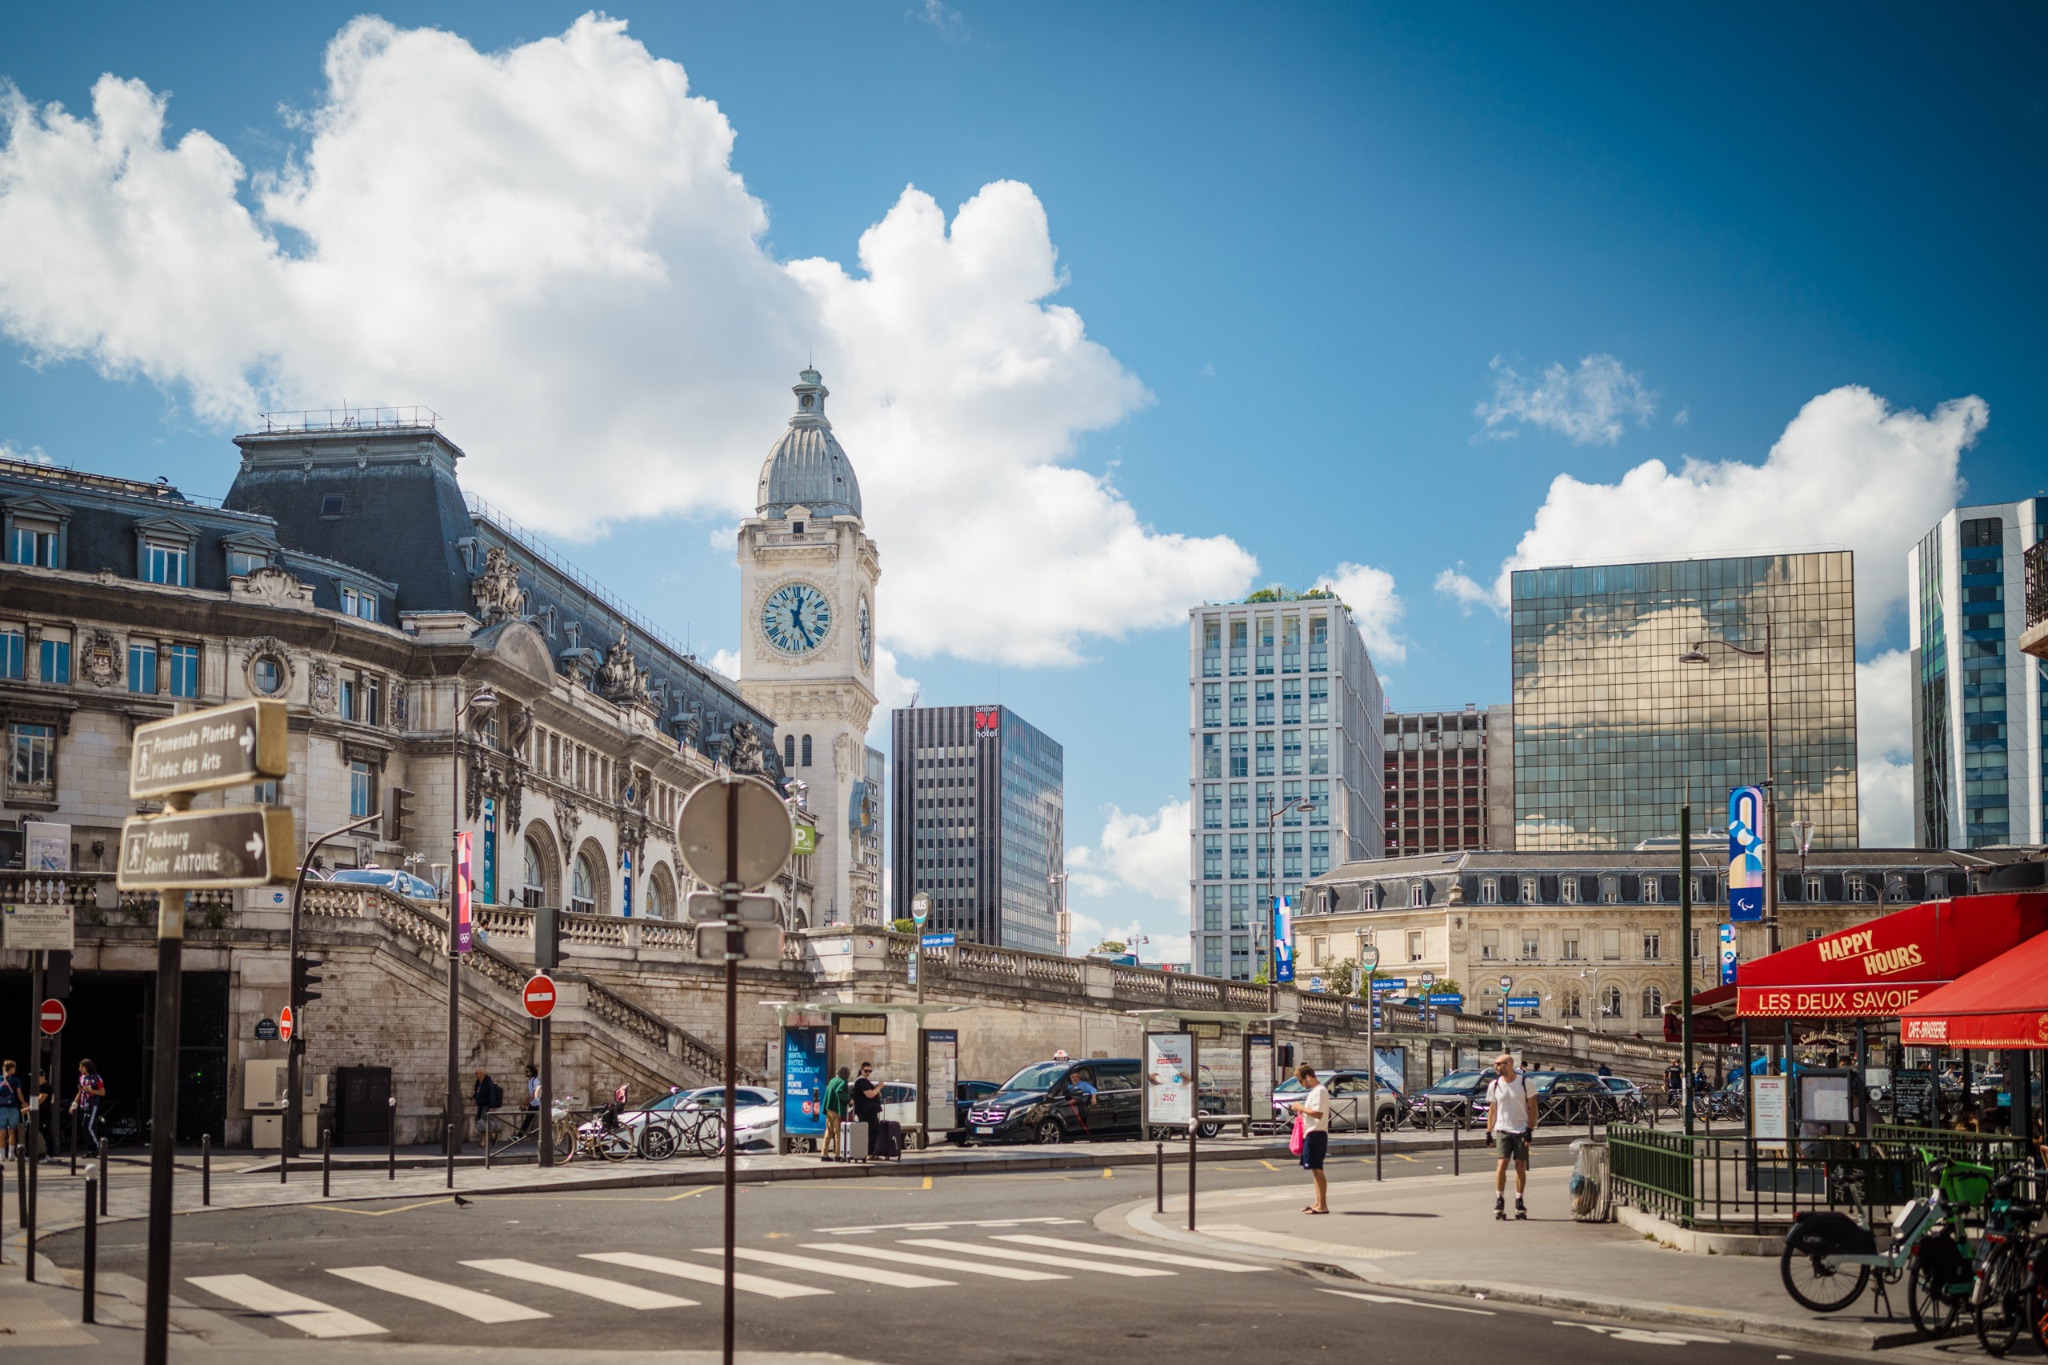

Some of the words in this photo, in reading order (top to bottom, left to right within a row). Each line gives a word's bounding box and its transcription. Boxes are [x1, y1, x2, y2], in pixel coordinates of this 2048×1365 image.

[806, 590, 813, 600] I
[813, 600, 825, 609] II
[154, 730, 198, 754] Promenade
[201, 721, 236, 745] Plantée
[152, 761, 180, 779] Viaduc
[182, 757, 198, 774] des
[201, 752, 221, 771] Arts
[147, 831, 189, 851] Faubourg
[795, 828, 806, 846] P
[144, 856, 169, 875] Saint
[174, 852, 219, 872] ANTOINE
[914, 900, 926, 910] BUS
[1818, 930, 1873, 962] HAPPY
[1363, 952, 1375, 960] BUS
[1863, 943, 1922, 976] HOURS
[1759, 994, 1791, 1010] LES
[1797, 992, 1846, 1010] DEUX
[1799, 1031, 1817, 1046] Salle
[1375, 1064, 1401, 1075] celio
